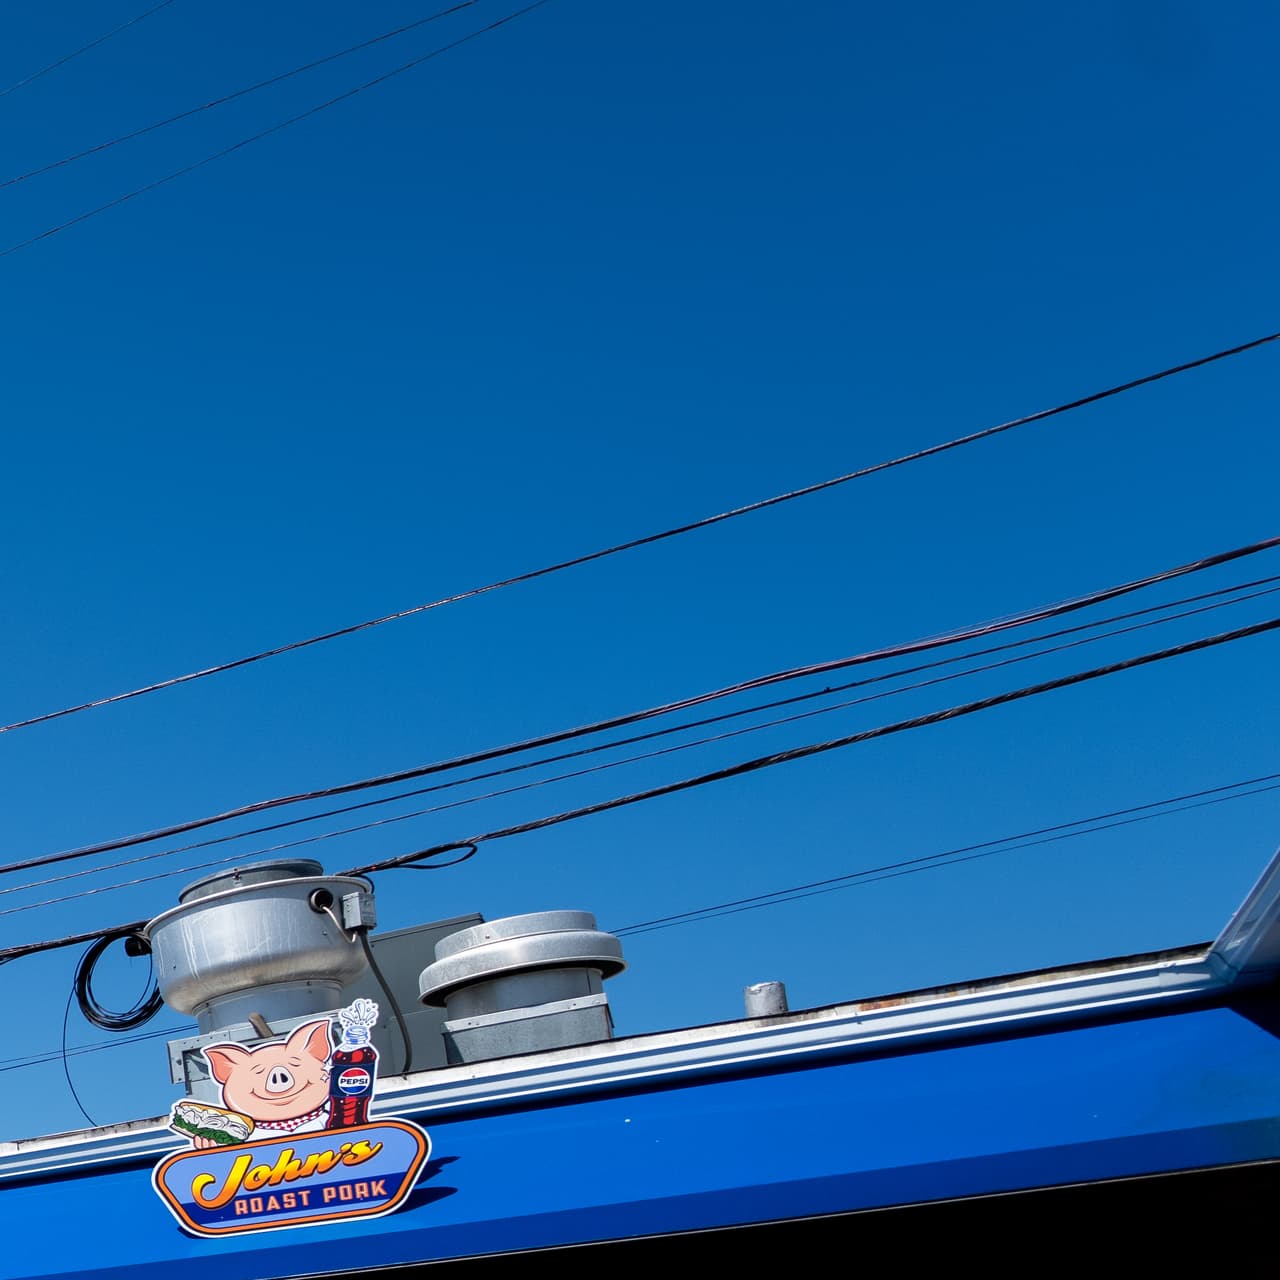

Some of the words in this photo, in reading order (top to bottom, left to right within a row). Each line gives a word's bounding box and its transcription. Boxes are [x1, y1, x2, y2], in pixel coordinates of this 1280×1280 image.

[191, 1138, 383, 1210] John's
[235, 1190, 310, 1216] ROAST
[323, 1179, 387, 1203] PORK
